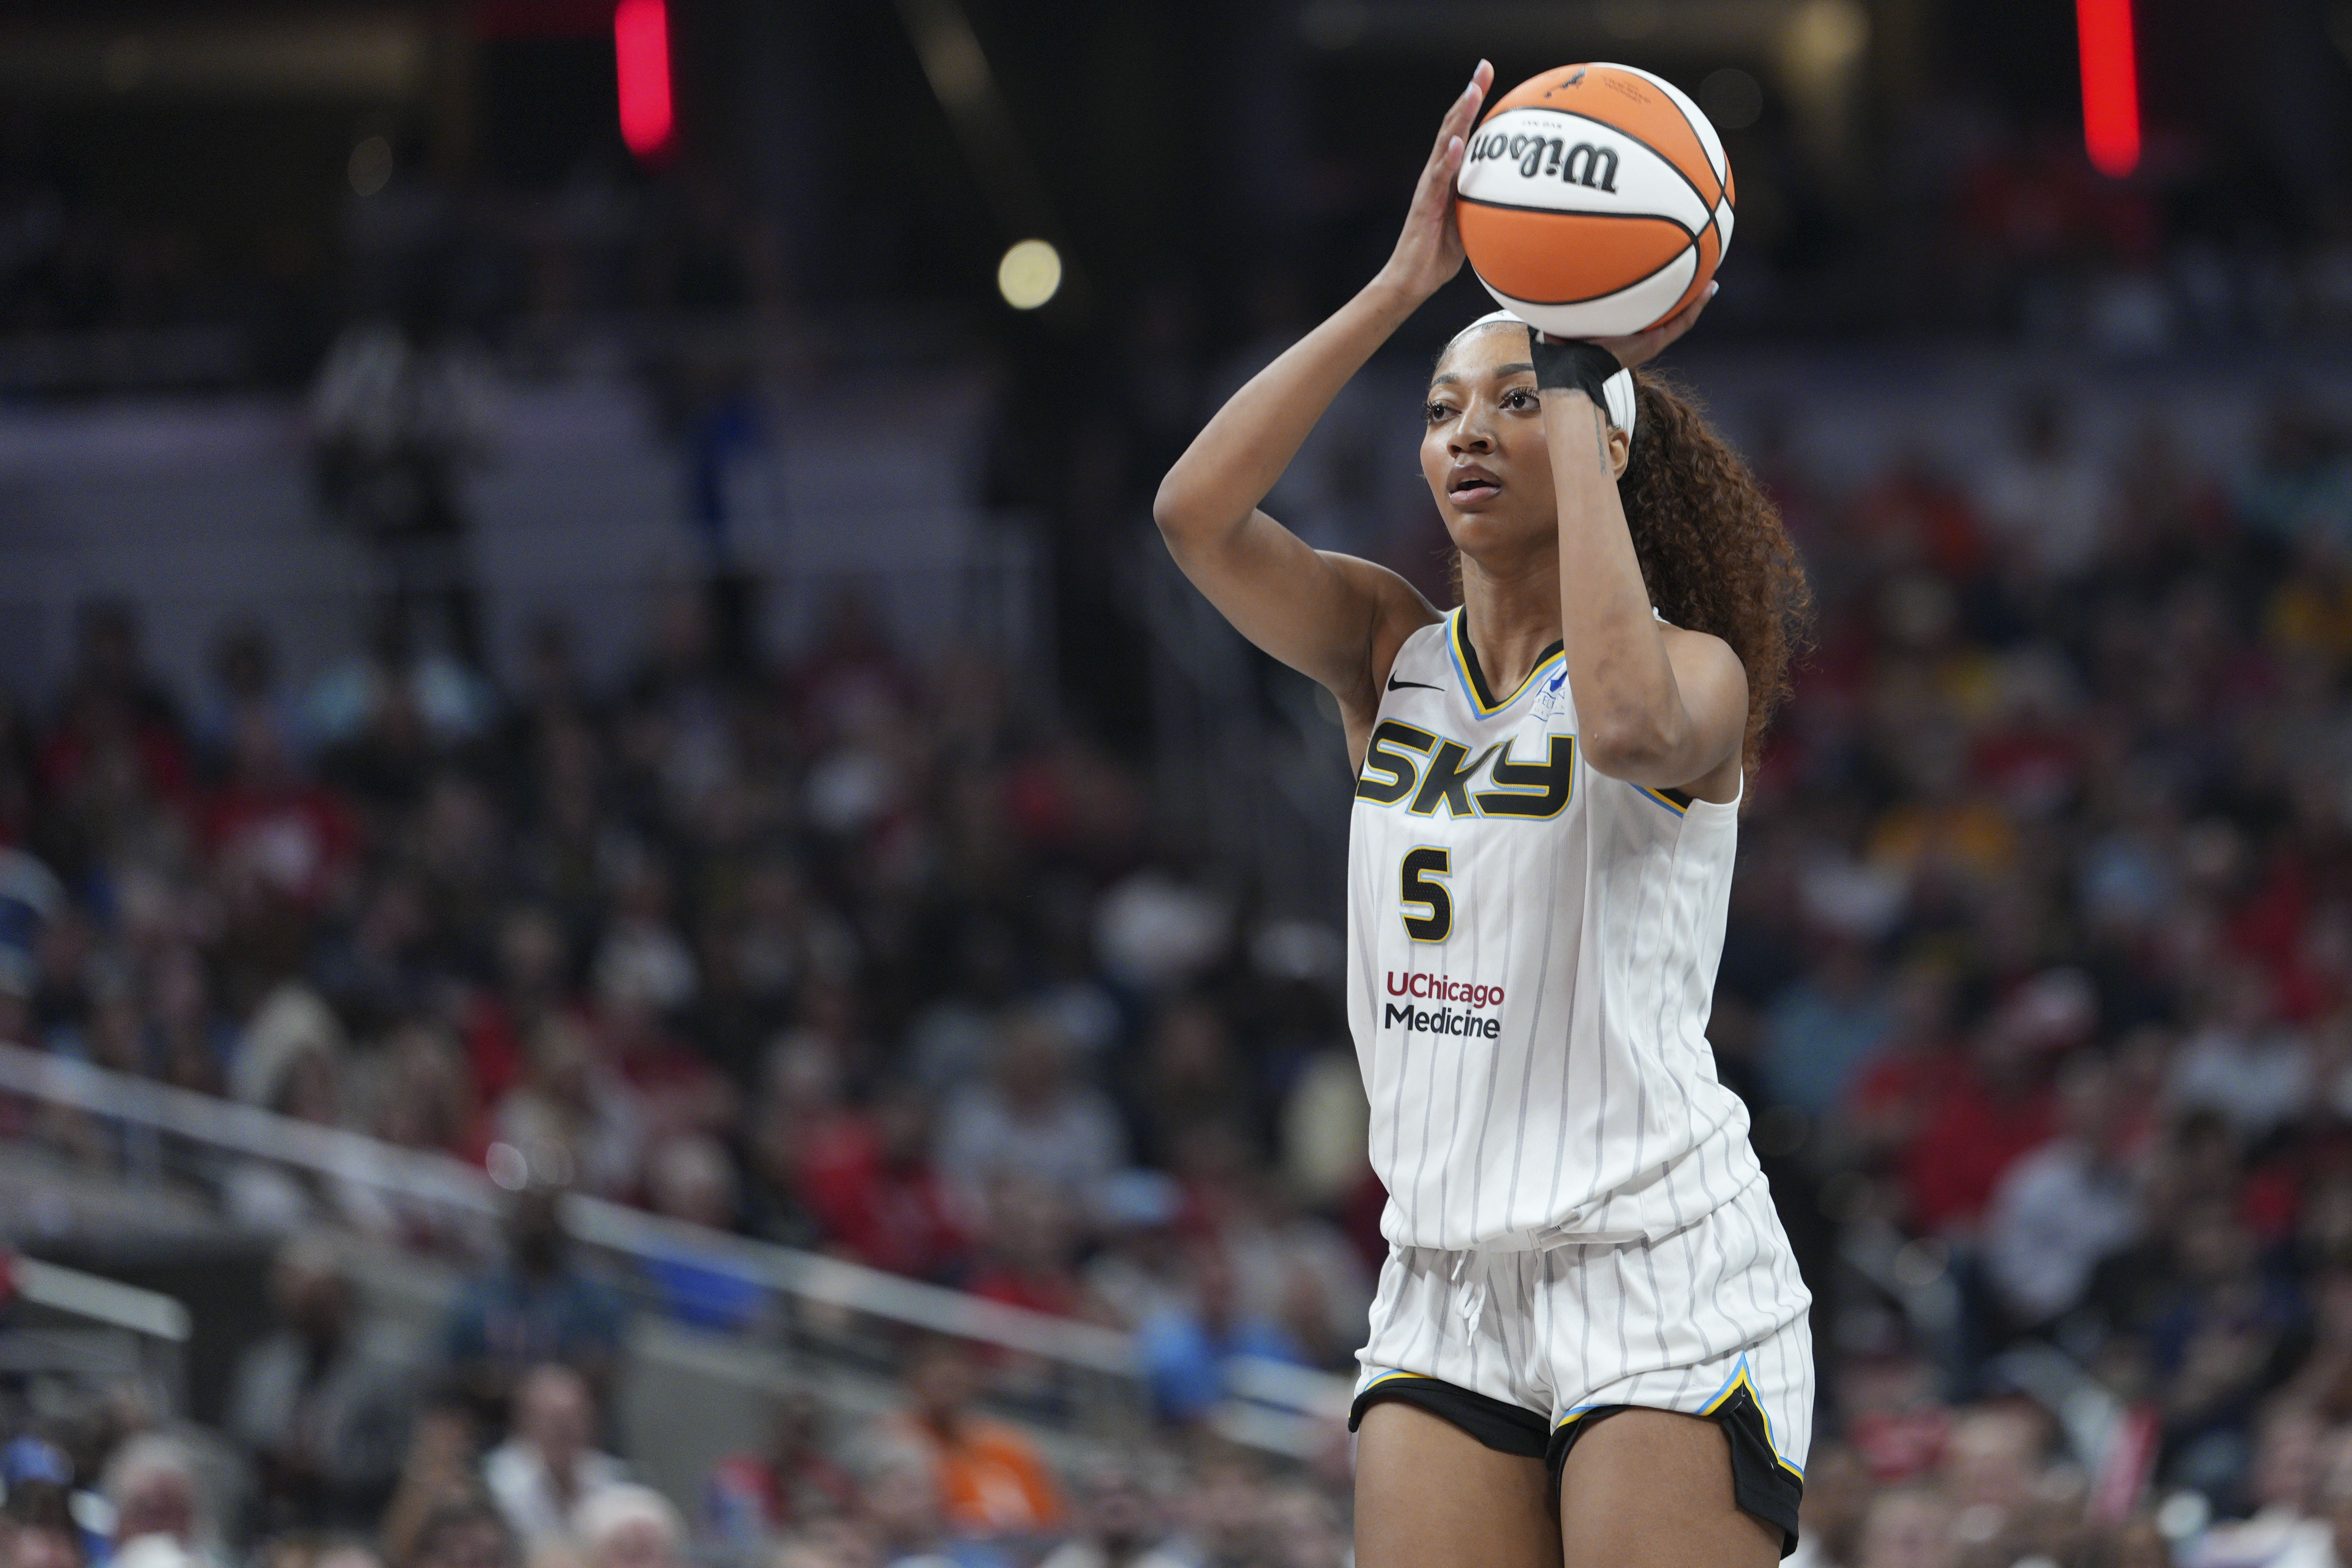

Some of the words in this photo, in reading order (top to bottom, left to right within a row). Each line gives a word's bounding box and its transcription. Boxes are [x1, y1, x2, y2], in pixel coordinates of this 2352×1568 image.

[1470, 134, 1619, 194] Wilson
[1354, 717, 1577, 821] SKY
[1399, 843, 1454, 945] 5
[1387, 971, 1504, 1008] UChicago
[1385, 1003, 1500, 1039] Medicine
